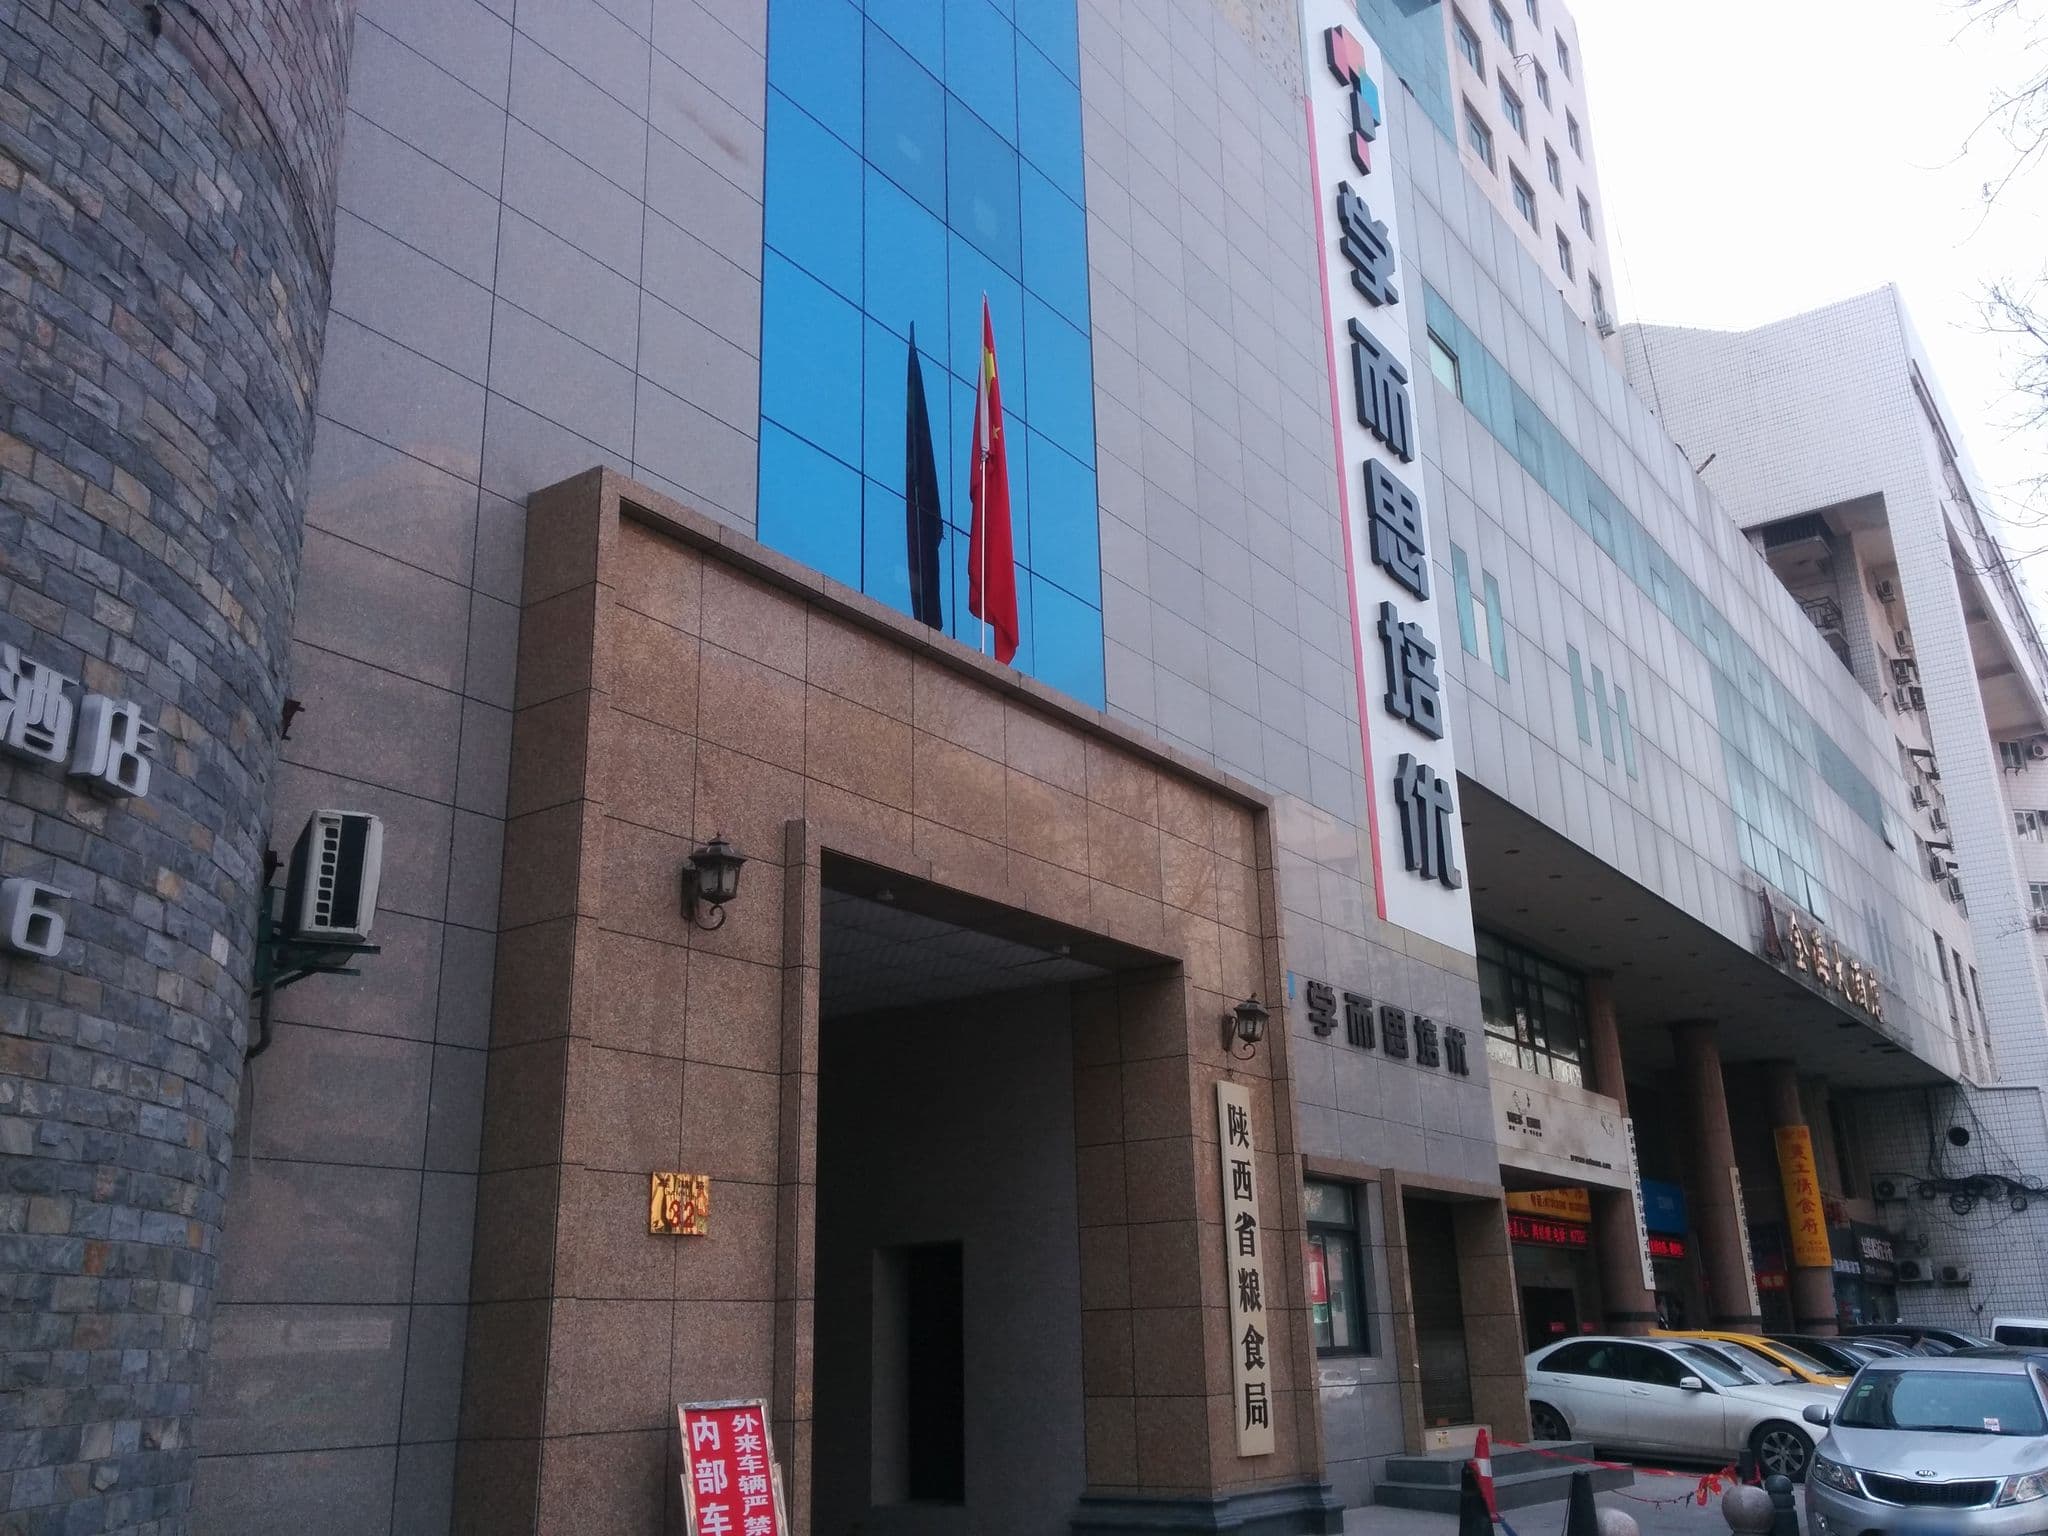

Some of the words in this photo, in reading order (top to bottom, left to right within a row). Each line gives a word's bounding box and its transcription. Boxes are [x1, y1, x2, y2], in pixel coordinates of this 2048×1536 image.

[1336, 180, 1463, 891] 学而思培优
[1307, 980, 1470, 1076] 学而思培优
[1227, 1102, 1269, 1431] 陕西省粮食局
[692, 1416, 732, 1536] 内部车
[731, 1414, 771, 1536] 外来车辆严禁
